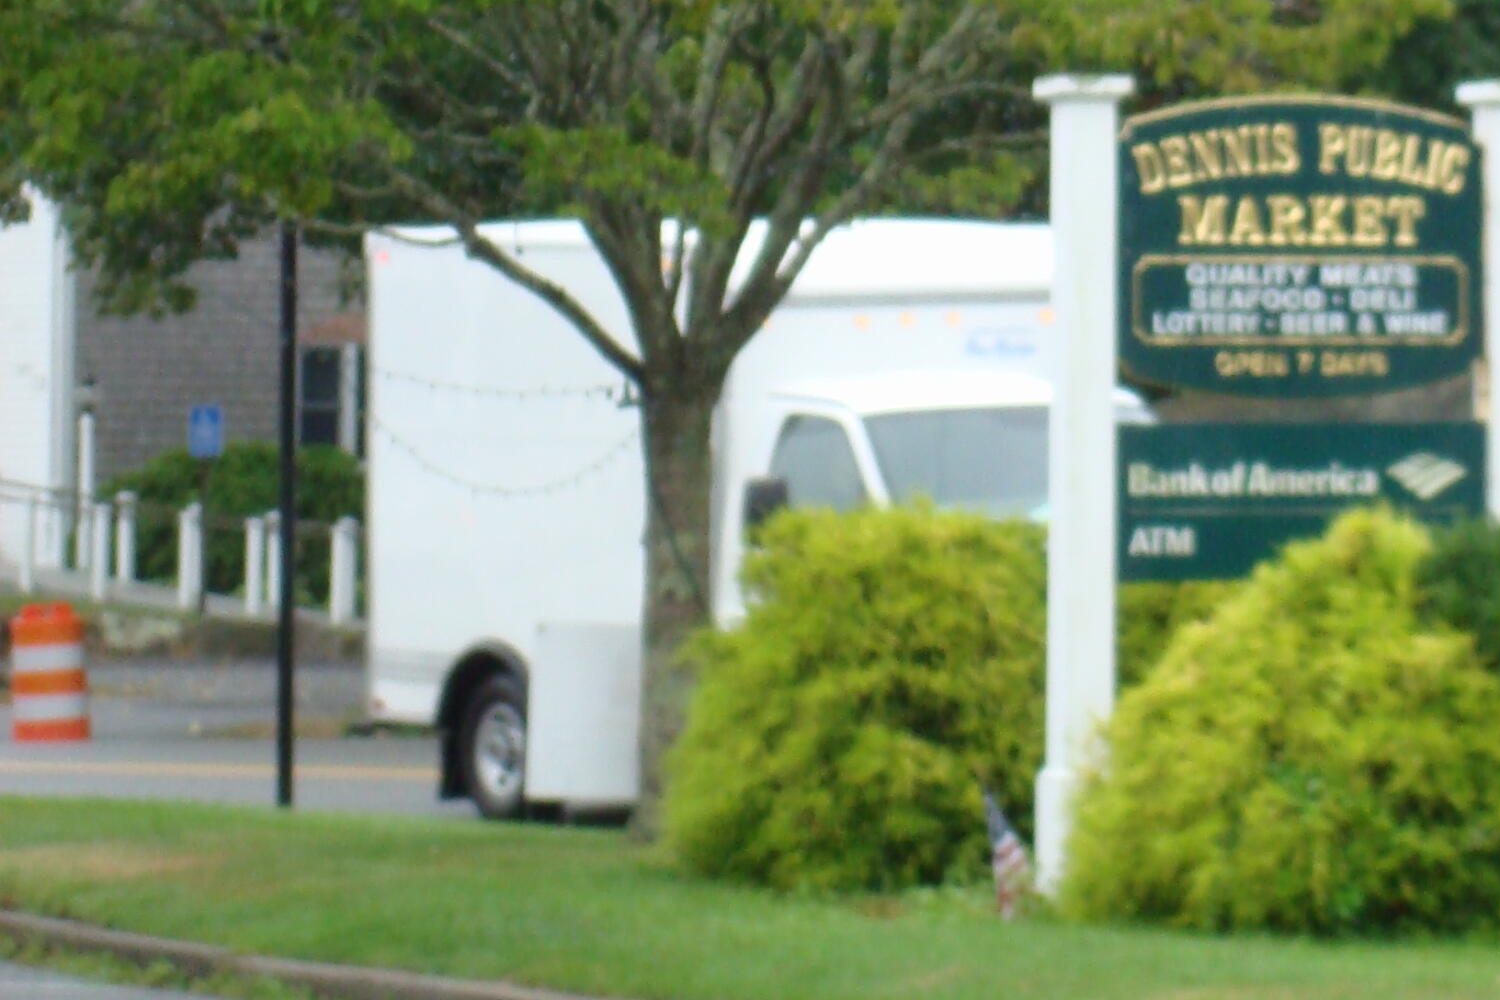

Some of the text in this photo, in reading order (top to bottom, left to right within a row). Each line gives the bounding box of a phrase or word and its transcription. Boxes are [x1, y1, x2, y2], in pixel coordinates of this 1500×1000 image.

[1132, 122, 1470, 195] DENNIS PUBLIC
[1177, 195, 1425, 247] MARKET
[1185, 262, 1417, 287] QUALITY MEATS
[1152, 311, 1261, 335] LOTTERY
[1280, 311, 1348, 335] BEER
[1383, 310, 1448, 335] WINE
[1214, 351, 1289, 377] OPEN
[1320, 351, 1388, 377] DAYS
[1127, 461, 1380, 497] Bank of America
[1127, 525, 1195, 557] ATM
